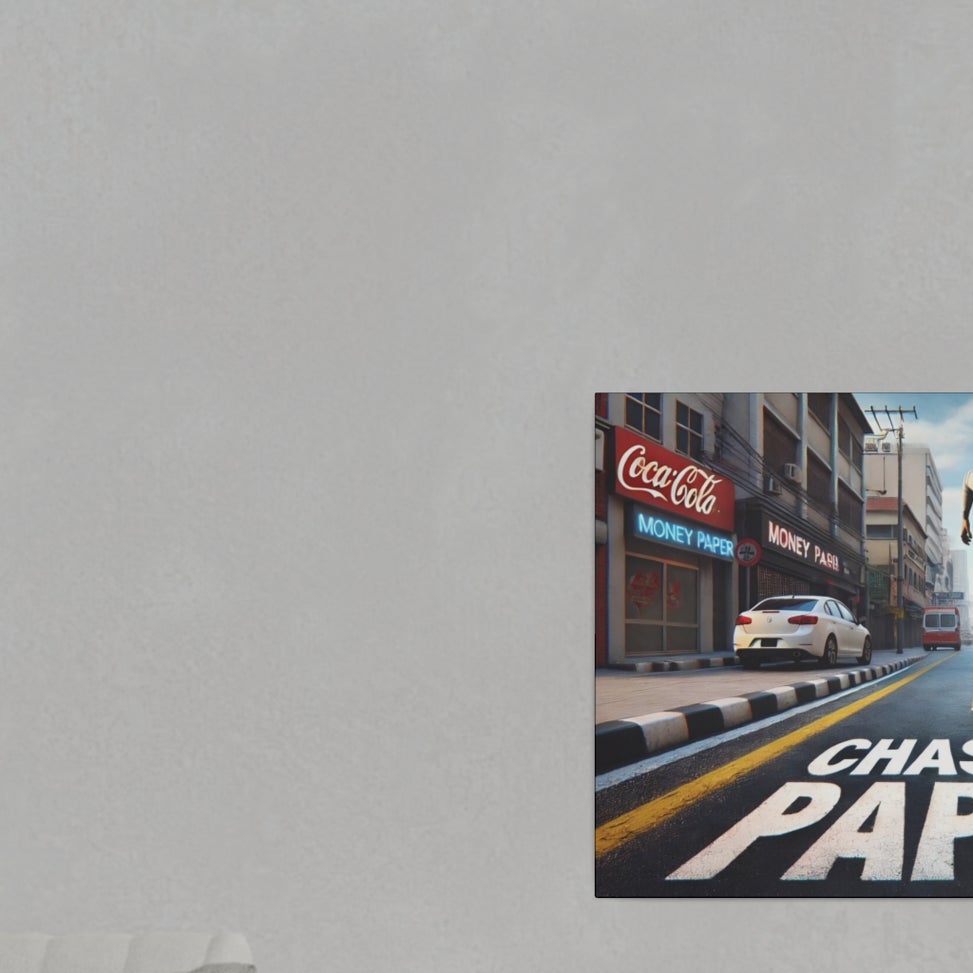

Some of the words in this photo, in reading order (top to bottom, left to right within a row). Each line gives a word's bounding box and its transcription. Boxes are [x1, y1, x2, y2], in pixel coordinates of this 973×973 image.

[637, 513, 693, 546] MONEY
[697, 530, 734, 558] PAPER
[768, 520, 810, 559] MONEY
